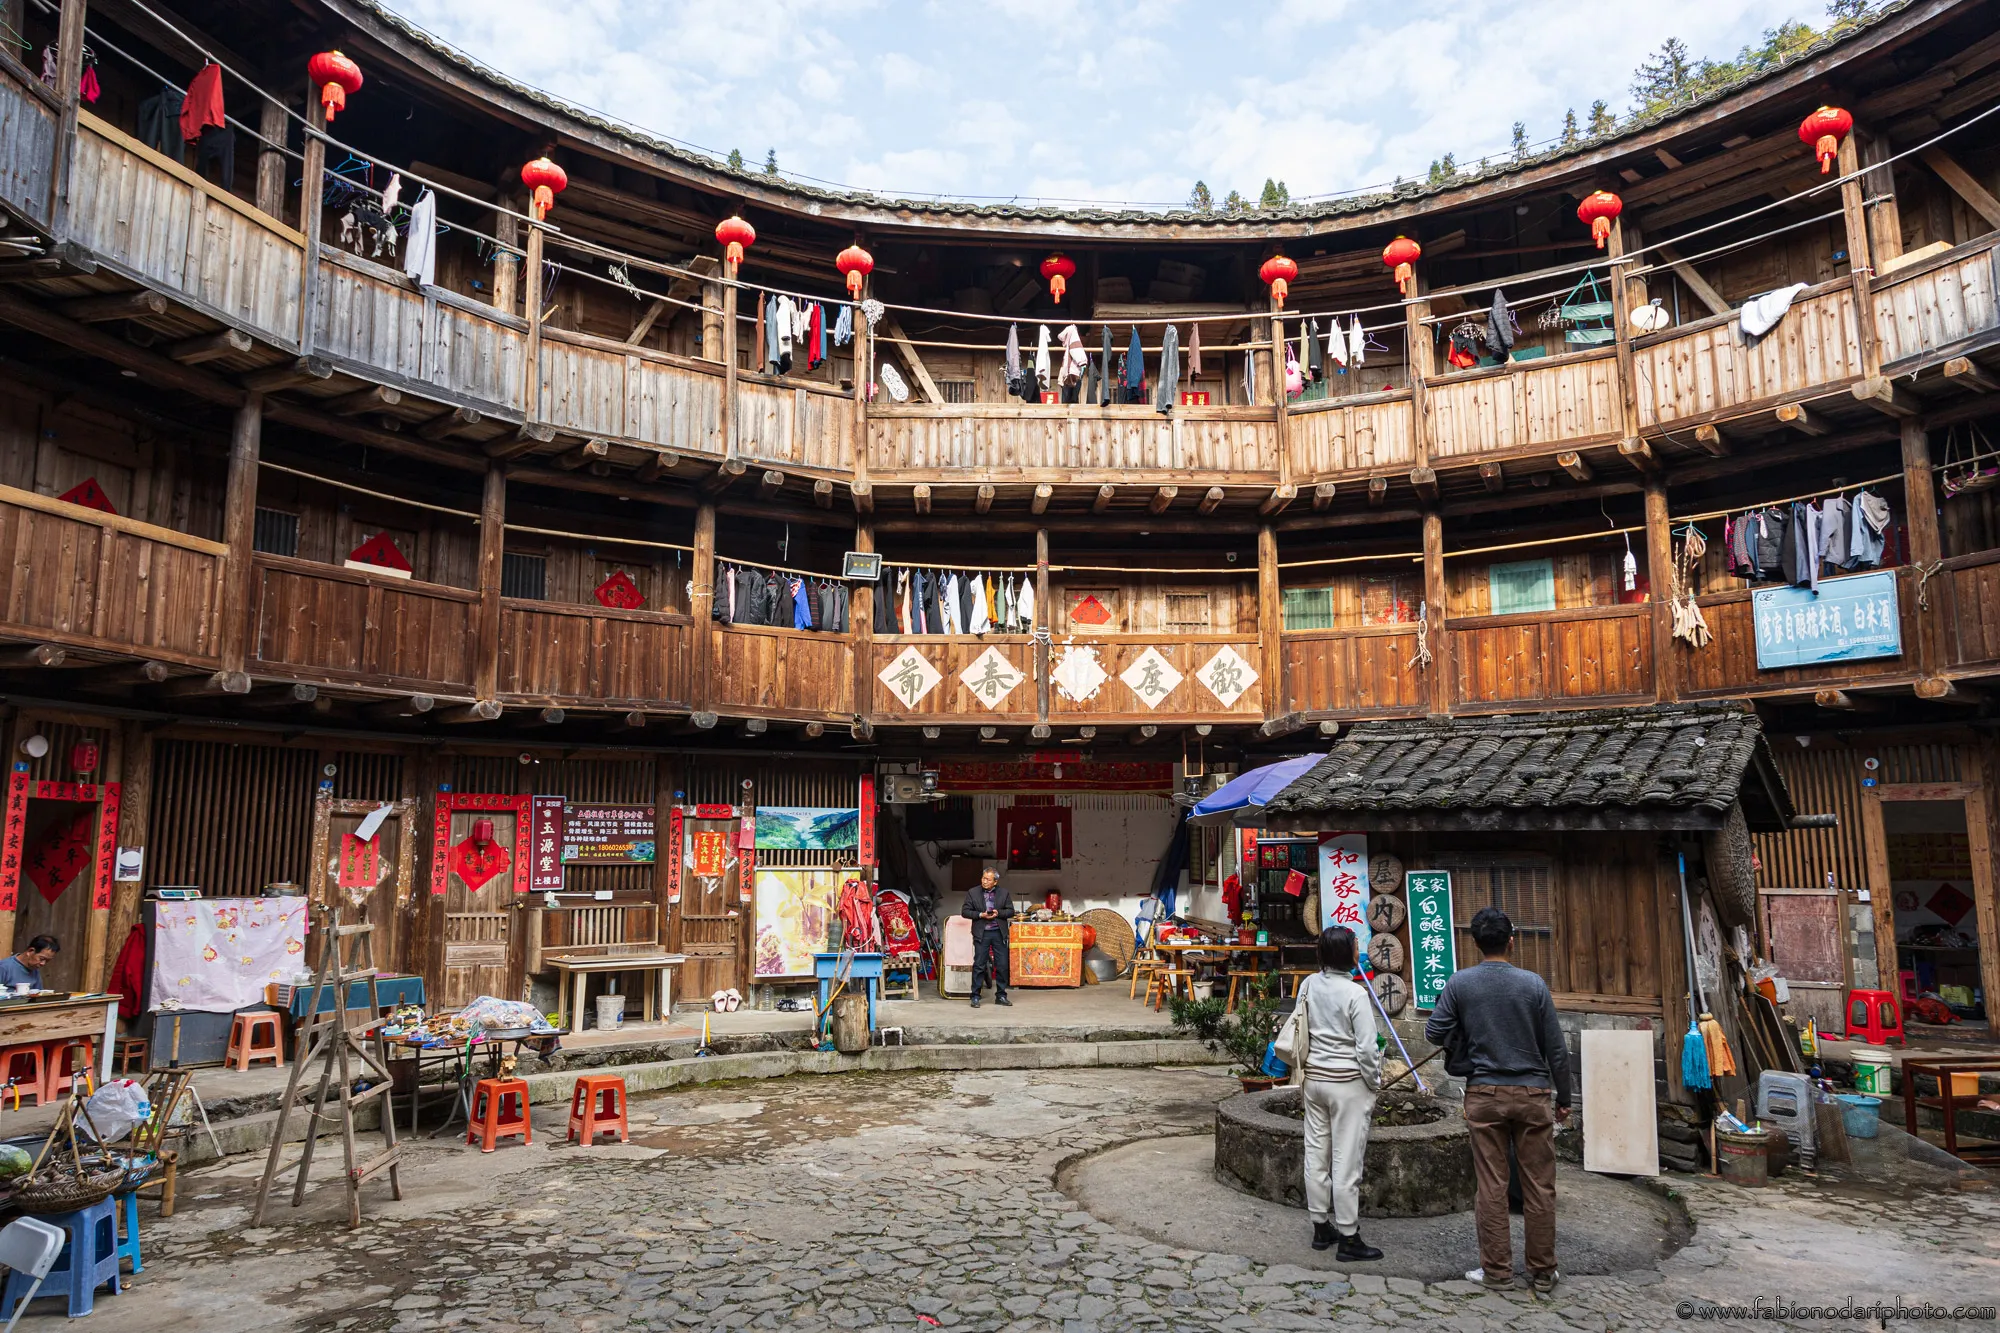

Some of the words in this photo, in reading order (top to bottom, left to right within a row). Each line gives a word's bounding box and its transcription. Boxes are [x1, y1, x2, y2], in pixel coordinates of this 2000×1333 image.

[540, 822, 555, 872] 玉源堂
[534, 876, 561, 885] 土楼店
[1328, 847, 1364, 926] 和家饭
[1412, 877, 1446, 893] 客家
